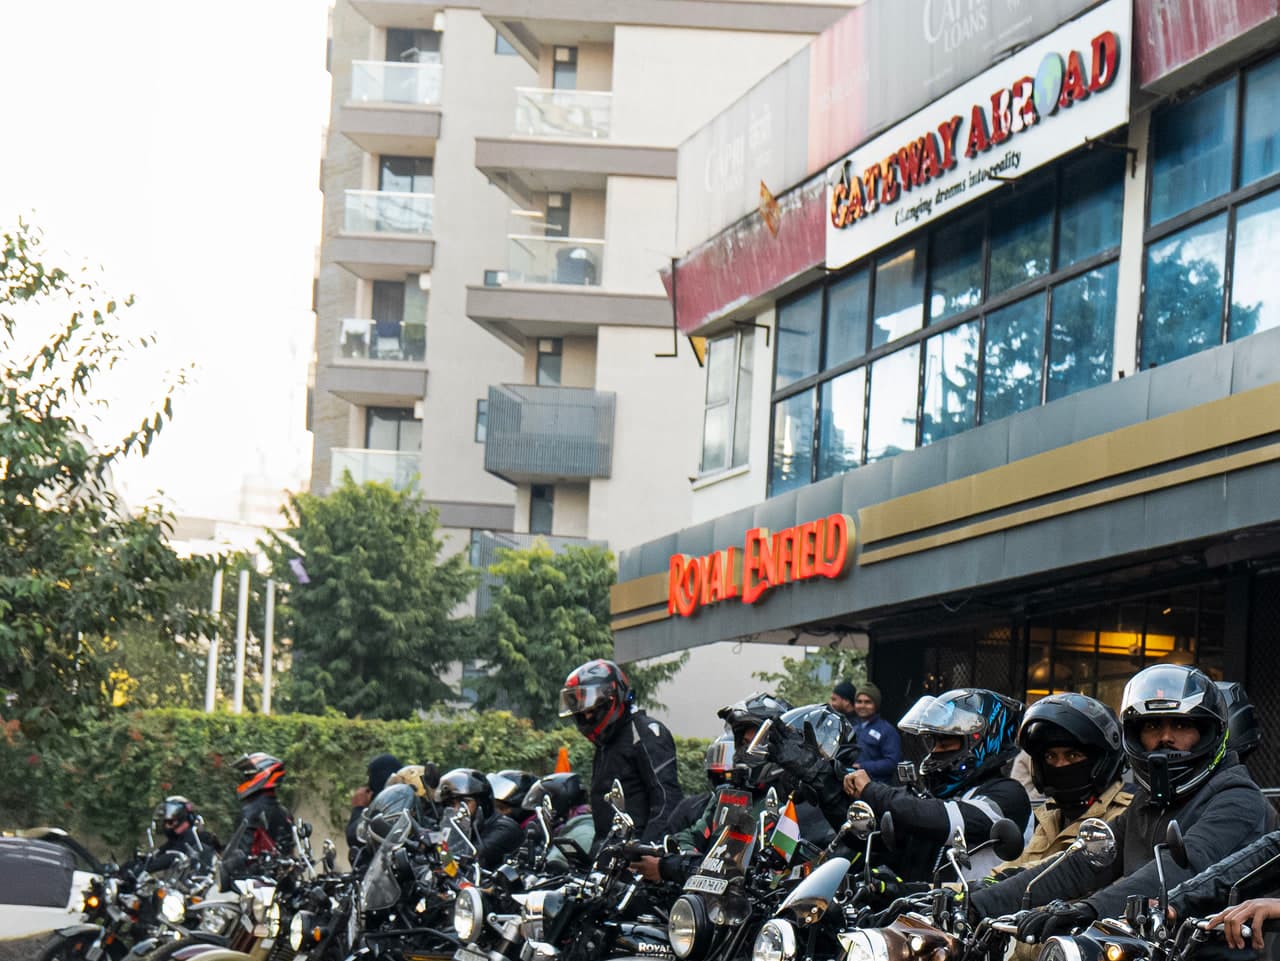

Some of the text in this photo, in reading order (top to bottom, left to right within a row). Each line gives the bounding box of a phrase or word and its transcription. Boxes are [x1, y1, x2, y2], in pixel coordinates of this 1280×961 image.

[944, 10, 988, 52] LOANS
[831, 115, 962, 229] GATEWAY
[965, 31, 1121, 158] ABROAD
[935, 179, 966, 205] dreams
[668, 513, 852, 617] ROYAL ENFIELD
[638, 942, 673, 953] ROYAL
